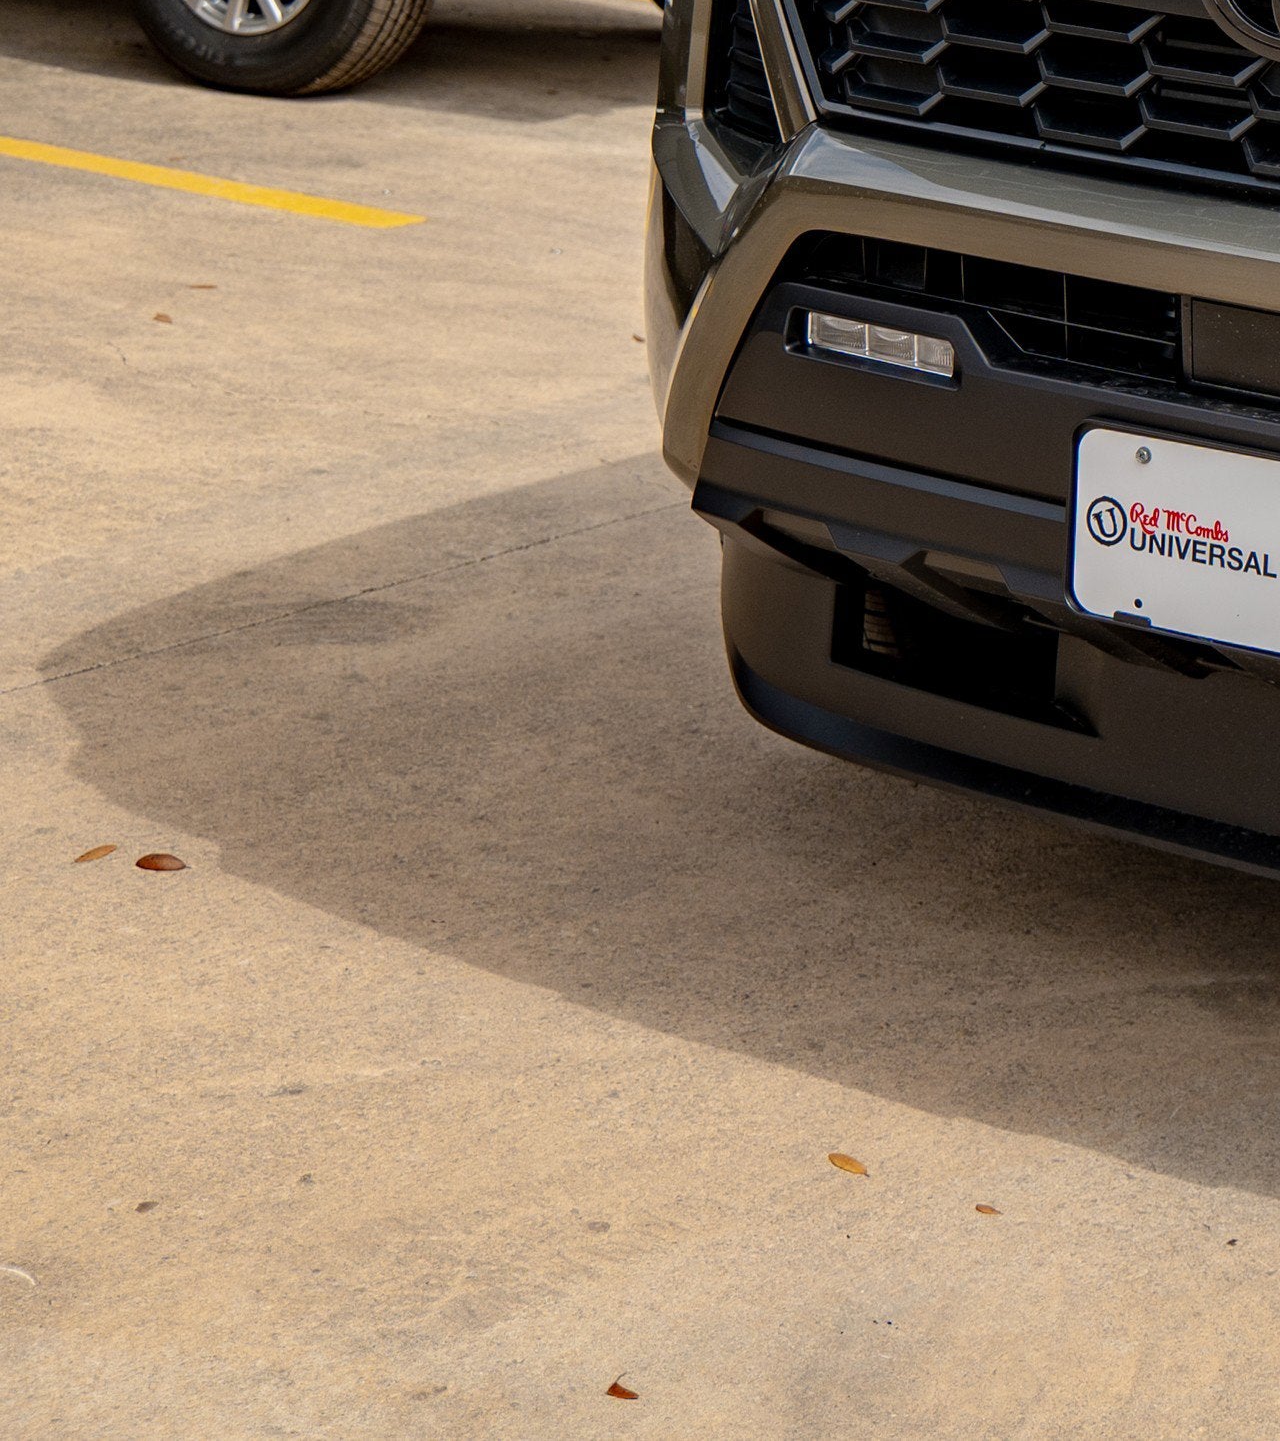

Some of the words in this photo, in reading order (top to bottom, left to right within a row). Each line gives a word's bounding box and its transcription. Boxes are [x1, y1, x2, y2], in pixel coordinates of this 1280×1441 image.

[1130, 503, 1160, 535] Red
[1163, 509, 1230, 543] McCombs
[1130, 528, 1277, 579] UNIVERSAL
